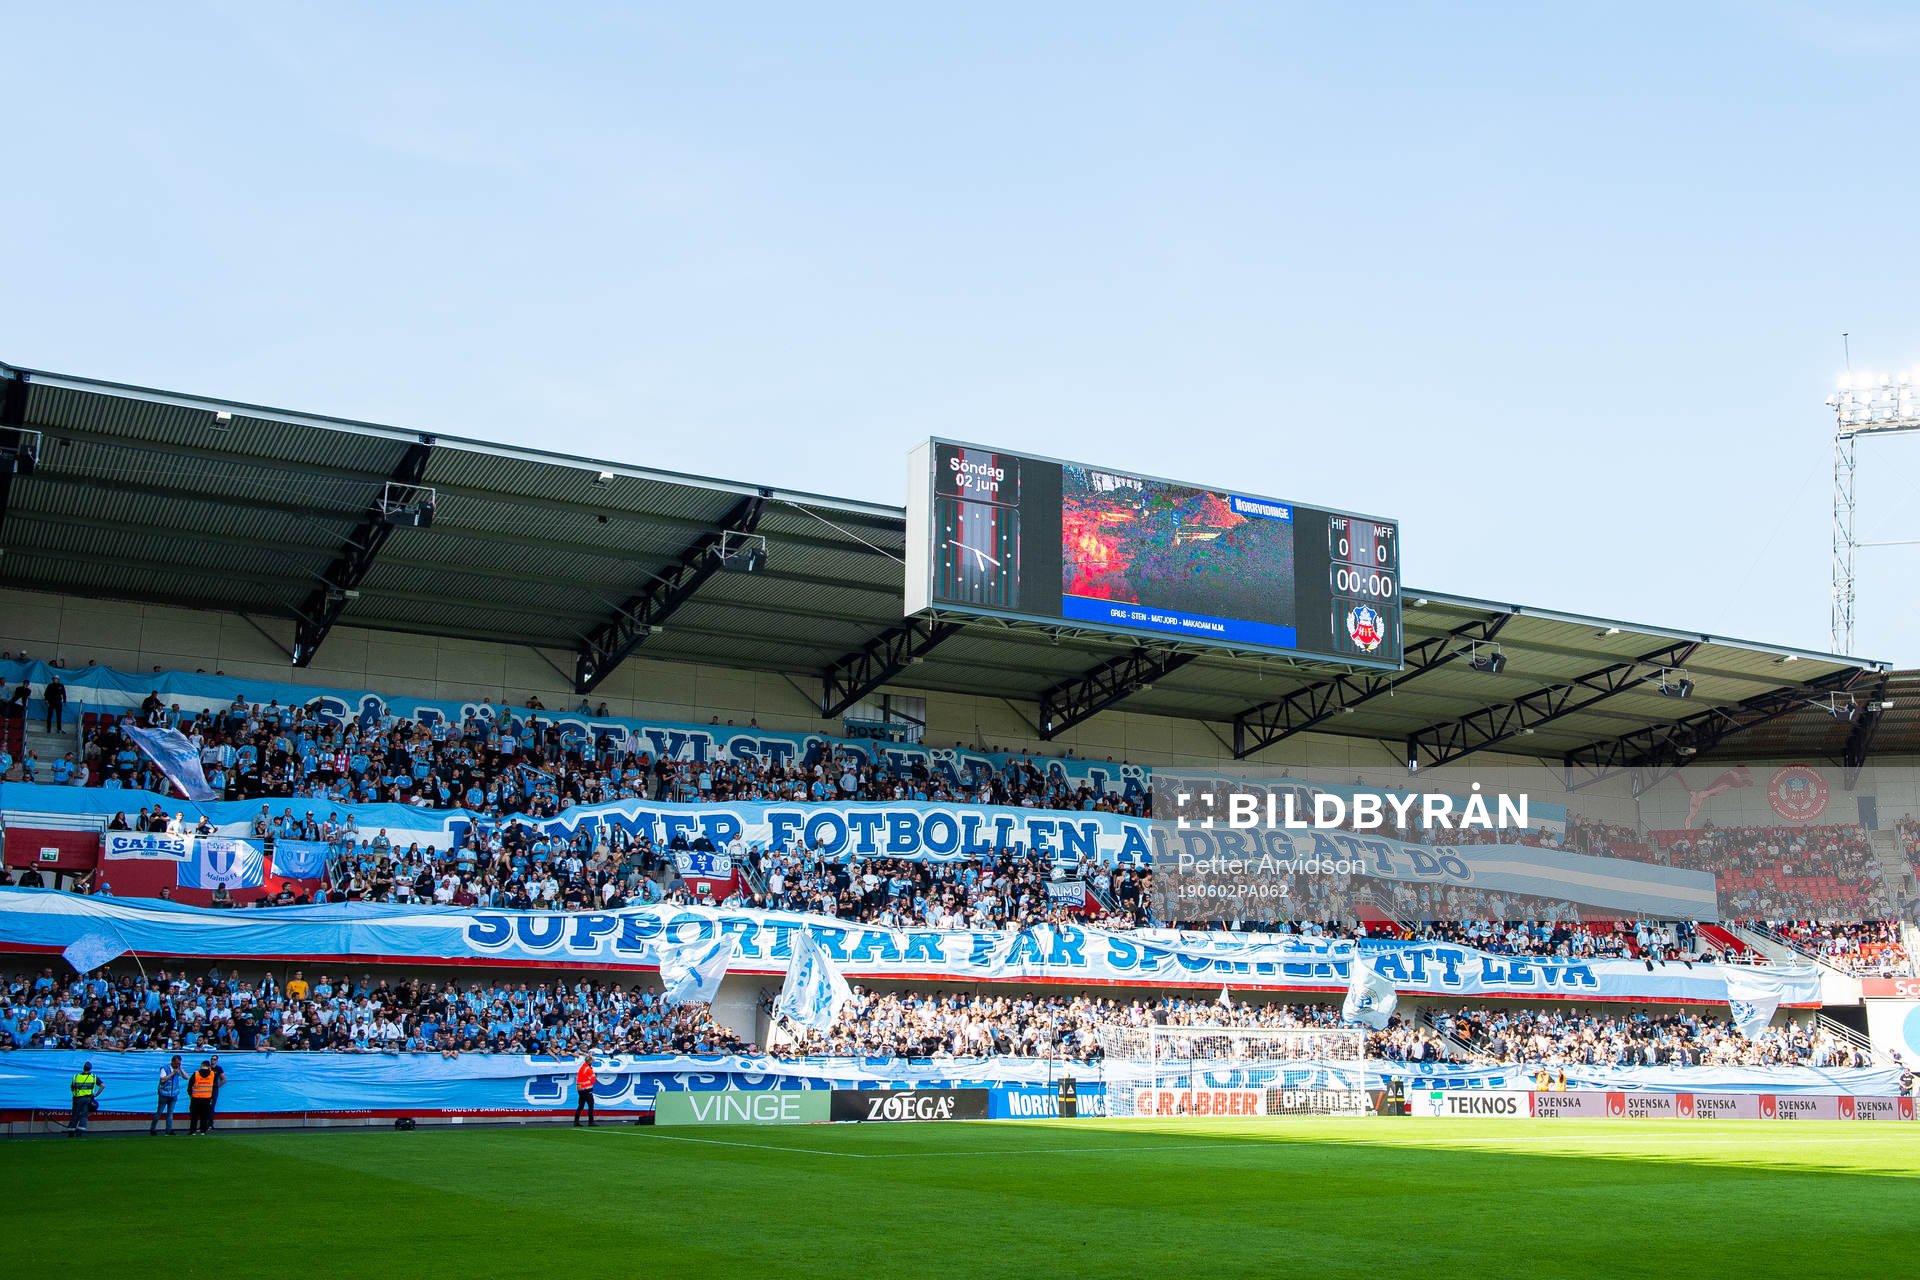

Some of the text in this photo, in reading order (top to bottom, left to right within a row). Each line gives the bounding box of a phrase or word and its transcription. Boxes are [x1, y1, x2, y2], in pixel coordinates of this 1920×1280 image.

[949, 457, 1005, 481] Söndag
[955, 473, 999, 492] 02 jun
[1234, 498, 1290, 519] NORRVIDINGE
[1331, 518, 1393, 539] HIF MFF
[1338, 538, 1349, 556] 0
[1376, 544, 1387, 563] 0
[1336, 569, 1393, 598] 00:00
[1110, 609, 1127, 619] GRUS
[1131, 612, 1147, 621] STEN
[1182, 619, 1211, 630] MAKADAM
[1358, 625, 1373, 637] HIF
[112, 836, 185, 852] GATES
[769, 811, 1099, 862] FOTBOLLEN
[1117, 825, 1298, 865] ALDRIG
[1310, 831, 1393, 873] ATT
[1403, 846, 1473, 881] DÖ
[676, 855, 690, 870] 19
[714, 858, 731, 872] 10
[207, 871, 230, 882] Malmö
[1049, 883, 1082, 897] ALMÖ
[467, 912, 946, 962] SUPPORTRAR
[1374, 947, 1466, 983] ATT
[1481, 956, 1597, 985] LEVA
[1895, 980, 1920, 996] Sc
[688, 1094, 800, 1121] VINGE
[1008, 1091, 1112, 1117] NORRVINGE
[1137, 1090, 1258, 1116] GRABBER
[1283, 1090, 1375, 1109] OPTIMERA
[1447, 1096, 1517, 1114] TEKNOS
[1538, 1097, 1582, 1108] SVENSKA
[1628, 1098, 1671, 1109] SVENSKA
[1696, 1099, 1737, 1110] SVENSKA
[1778, 1100, 1817, 1111] SVENSKA
[1857, 1101, 1893, 1112] SVENSKA
[1538, 1109, 1561, 1118] SPEL
[1628, 1110, 1650, 1118] SPEL
[1697, 1111, 1717, 1119] SPEL
[1778, 1111, 1799, 1120] SPEL
[1857, 1112, 1877, 1120] SPEL
